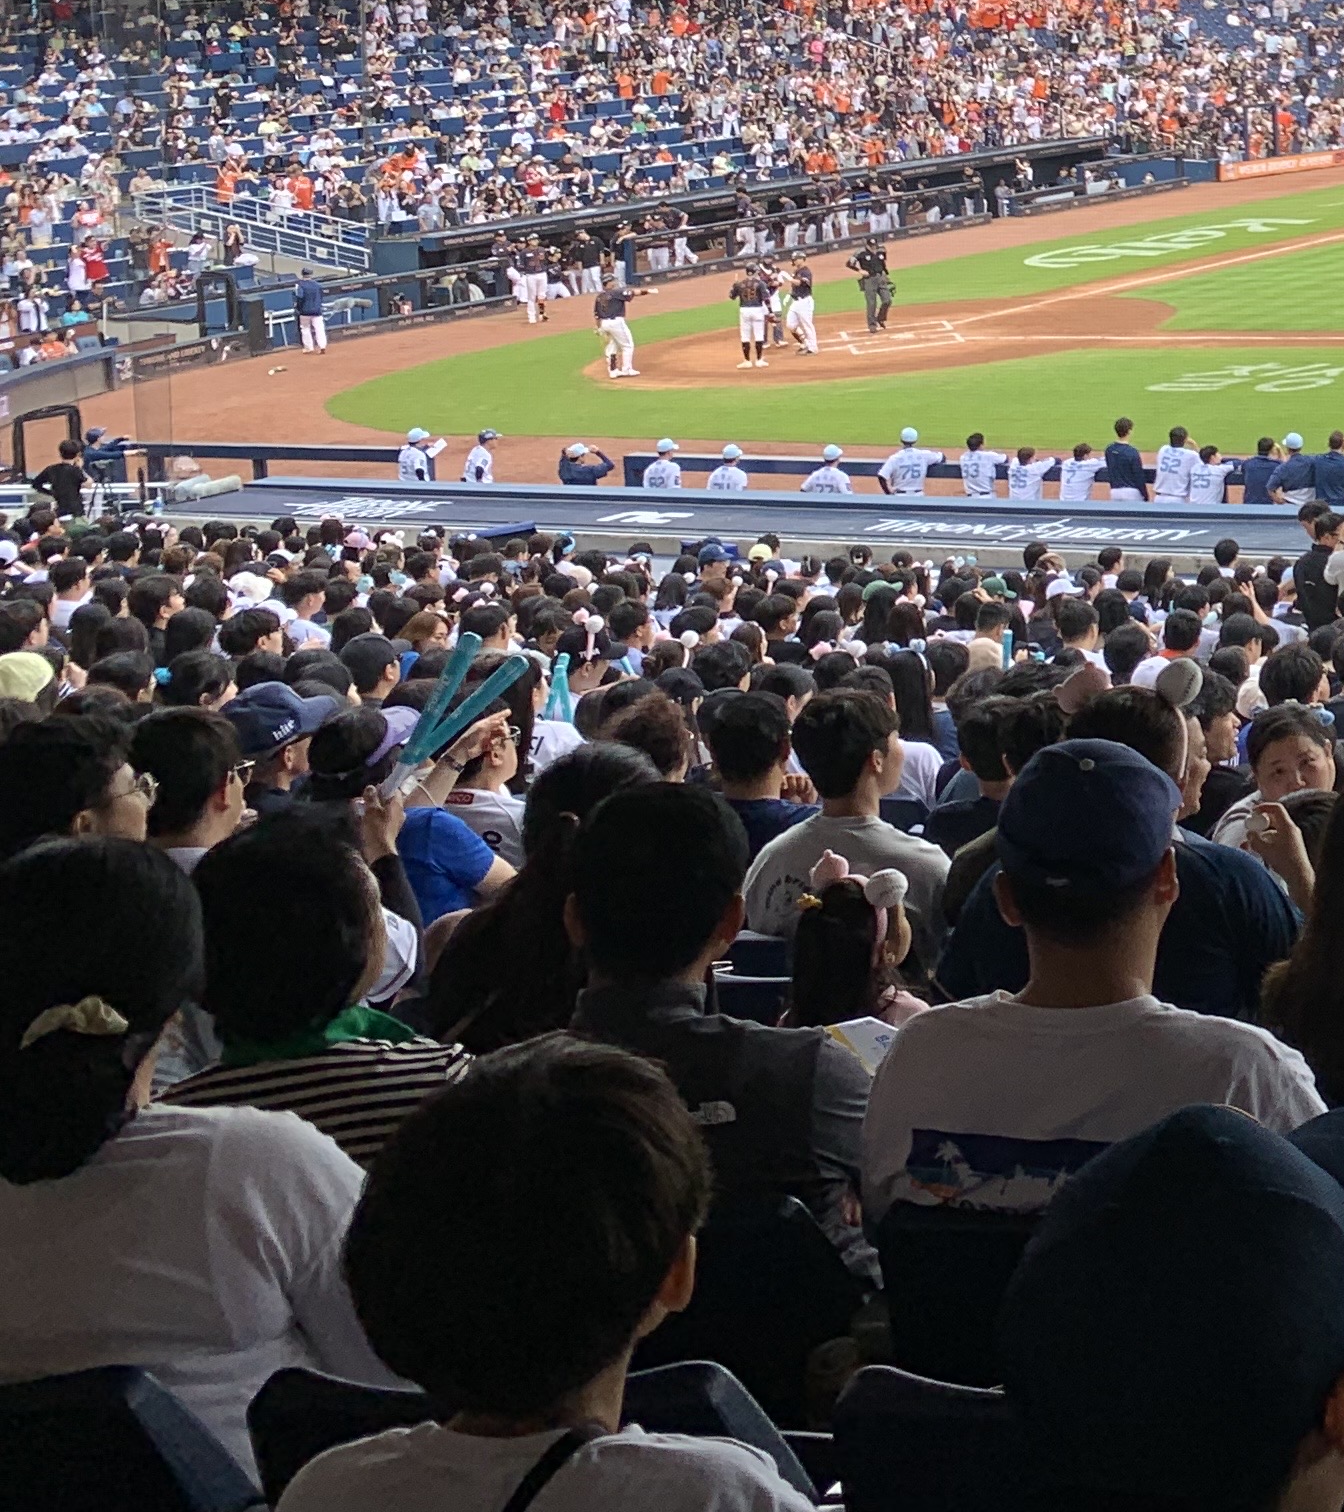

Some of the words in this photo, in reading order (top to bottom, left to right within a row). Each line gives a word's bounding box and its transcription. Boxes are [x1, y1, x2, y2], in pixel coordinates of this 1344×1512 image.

[1159, 459, 1182, 474] 52
[1193, 473, 1211, 488] 25
[271, 719, 297, 741] hite
